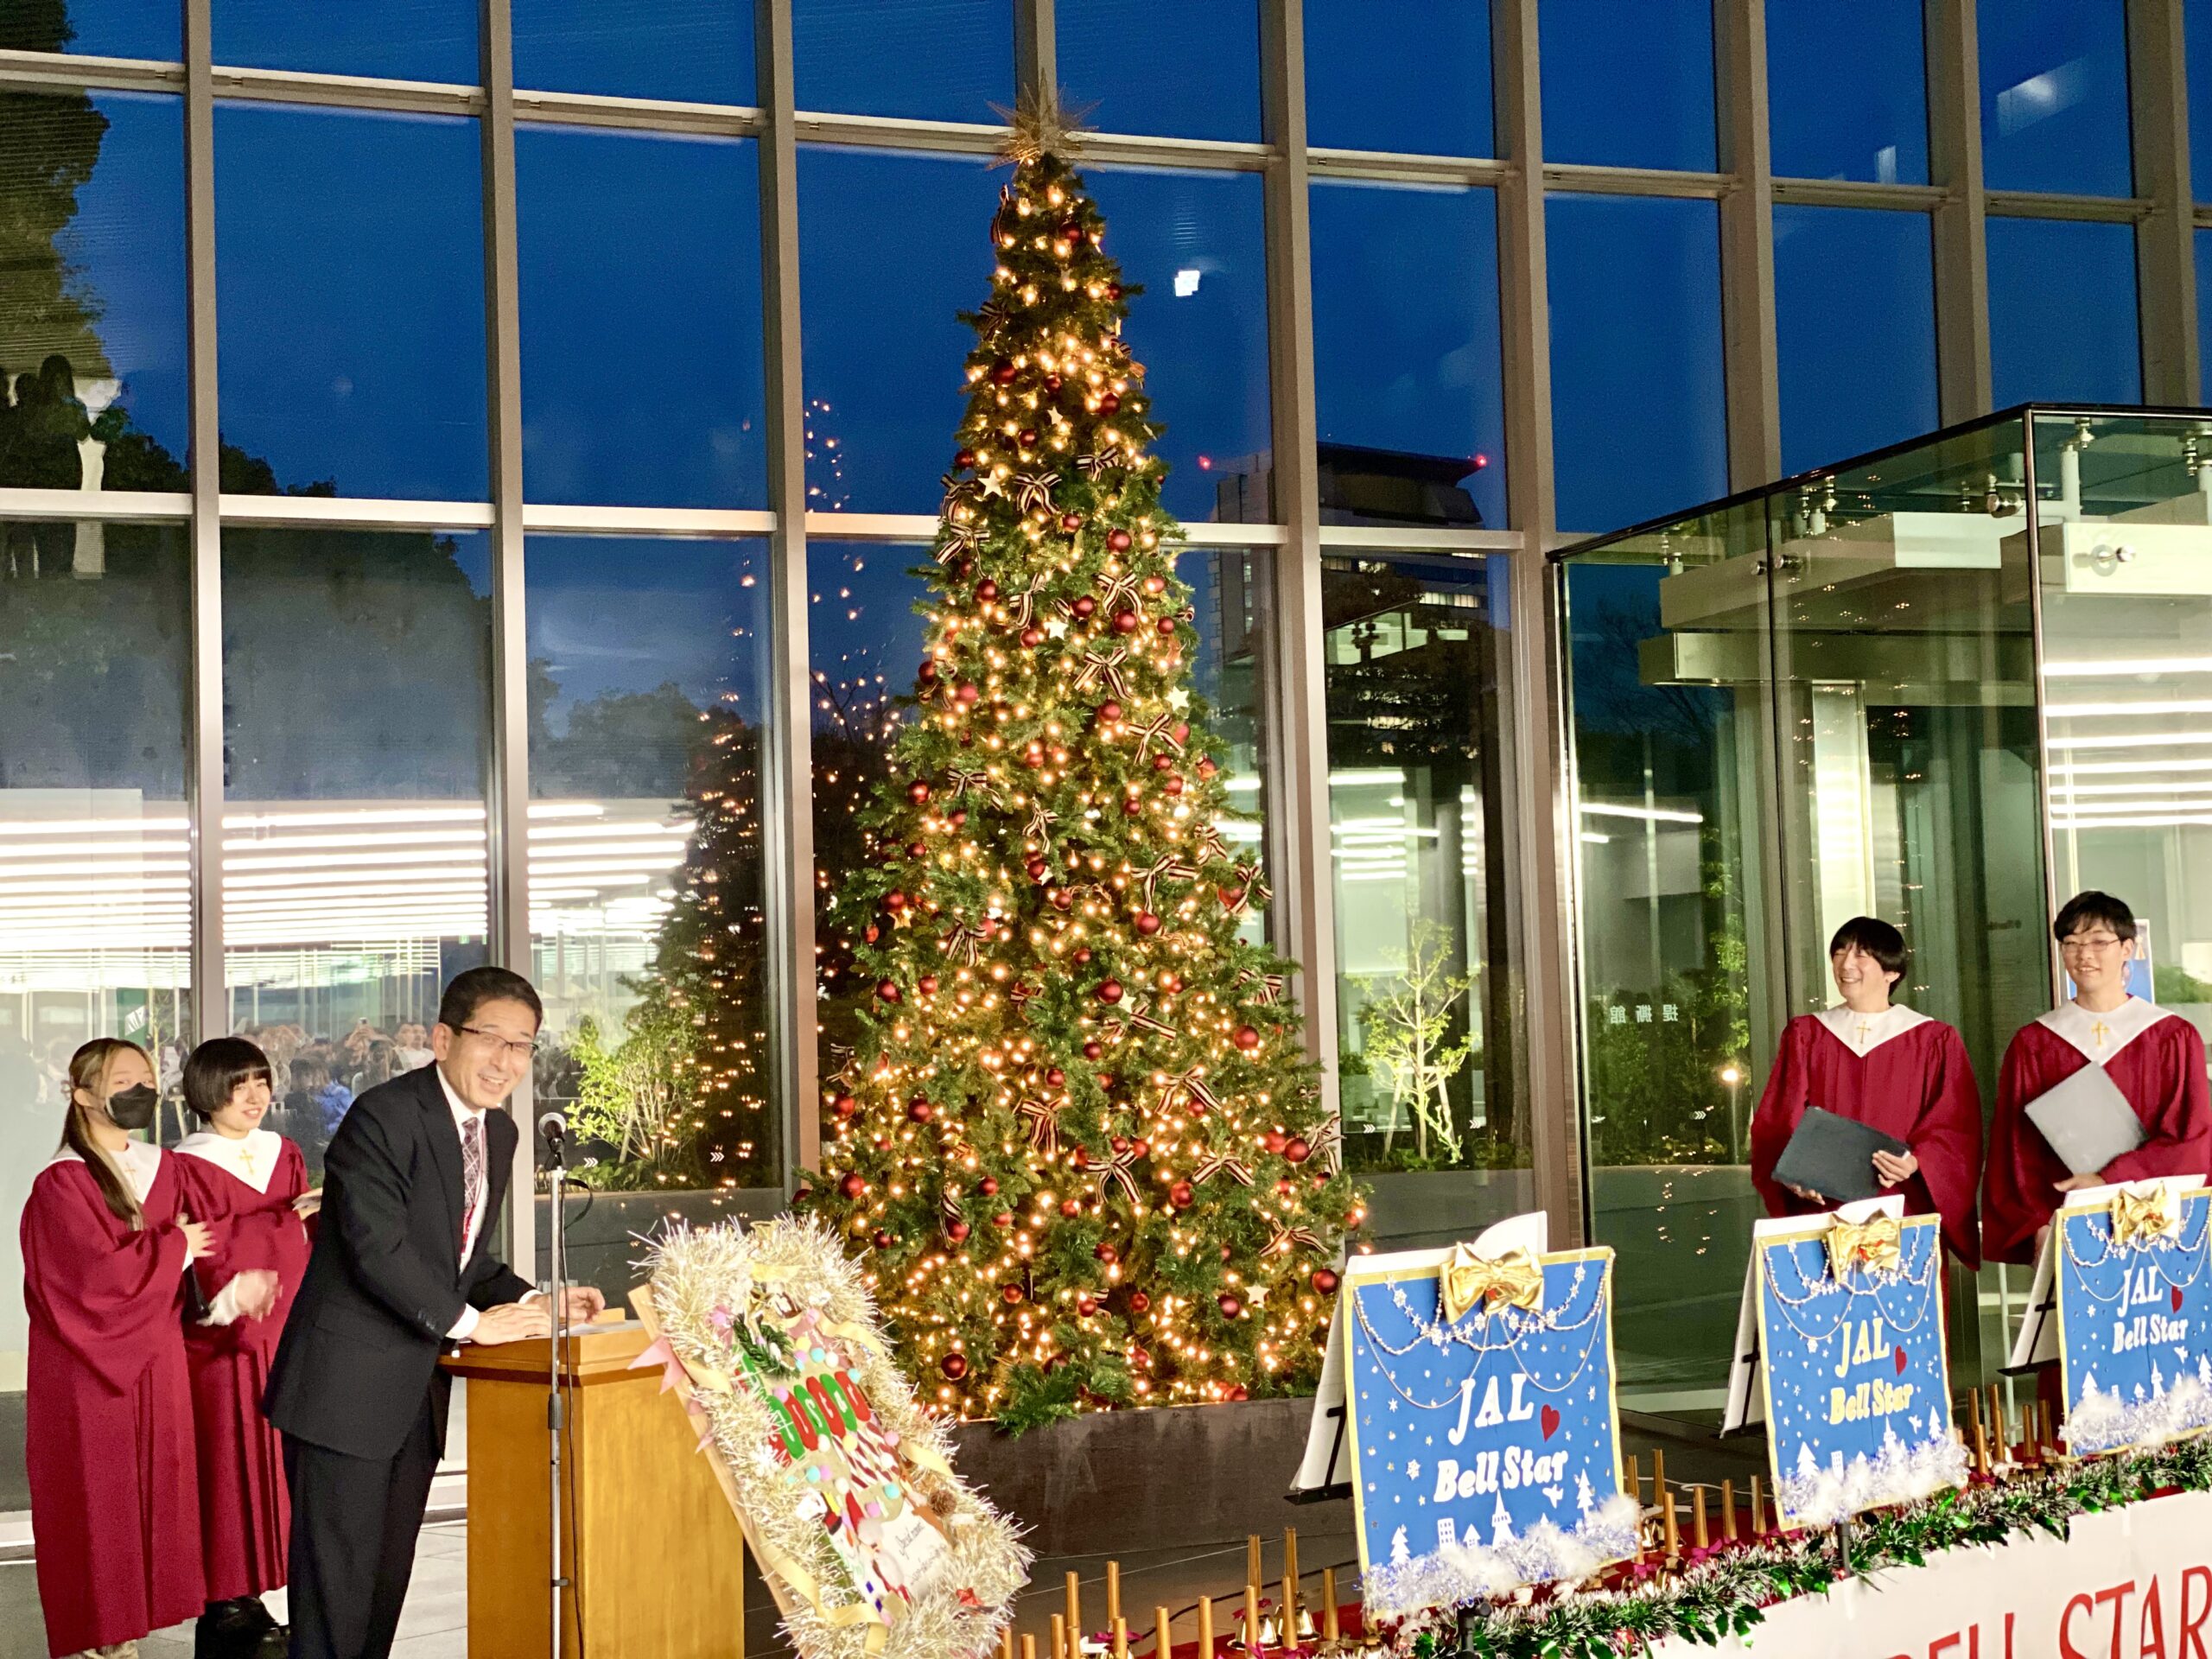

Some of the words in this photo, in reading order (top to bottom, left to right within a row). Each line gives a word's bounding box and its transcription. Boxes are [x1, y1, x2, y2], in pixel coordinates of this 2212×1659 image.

[2117, 1264, 2163, 1318] JAL
[1834, 1318, 1890, 1378] JAL
[2112, 1315, 2147, 1354] Bell
[2148, 1313, 2188, 1344] Star
[1448, 1373, 1535, 1446] JAL
[1830, 1382, 1871, 1425] Bell
[1872, 1377, 1913, 1416] Star
[1433, 1452, 1498, 1503] Bell
[1503, 1446, 1568, 1489] Star
